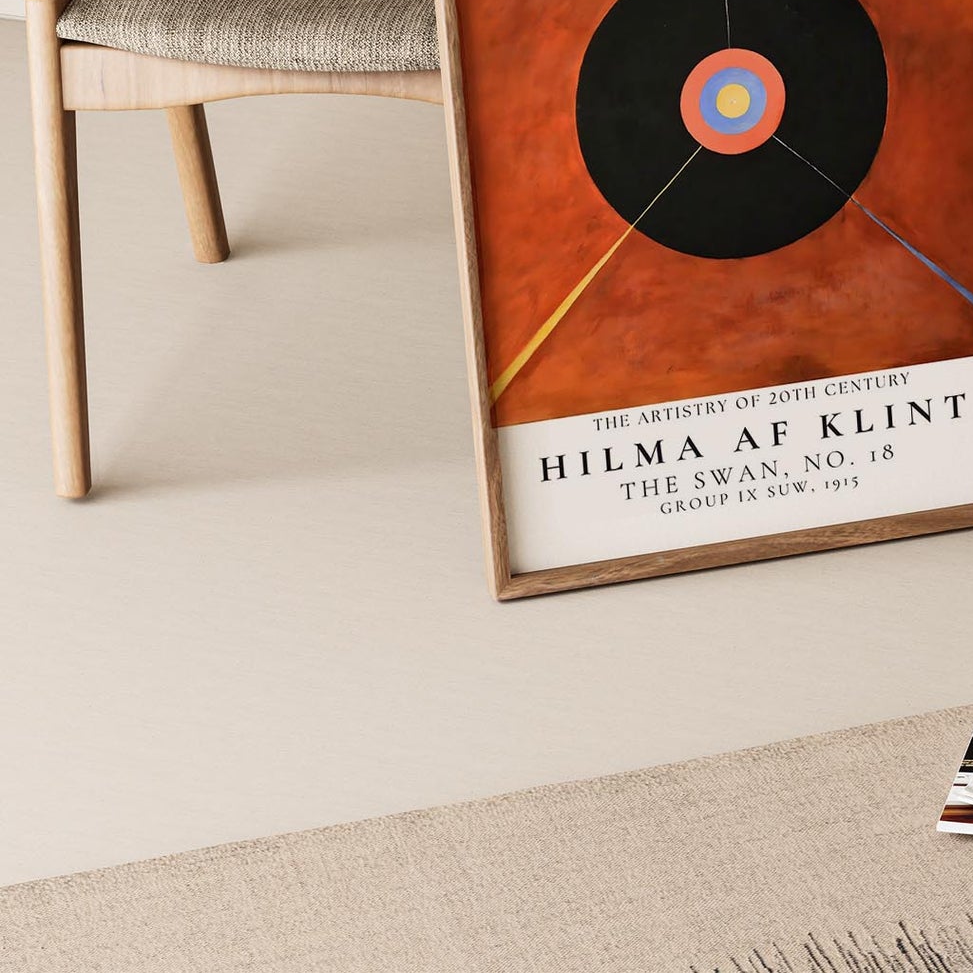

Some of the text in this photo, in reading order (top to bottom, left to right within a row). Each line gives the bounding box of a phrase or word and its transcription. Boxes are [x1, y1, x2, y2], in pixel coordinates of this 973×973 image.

[593, 372, 911, 431] THE ARTISTRY OF 20TH CENTURY
[540, 392, 967, 482] HILMA AF KLINT
[620, 443, 895, 501] THE SWAN, NO. 18
[660, 475, 860, 515] GROUP IX SUW, 1915
